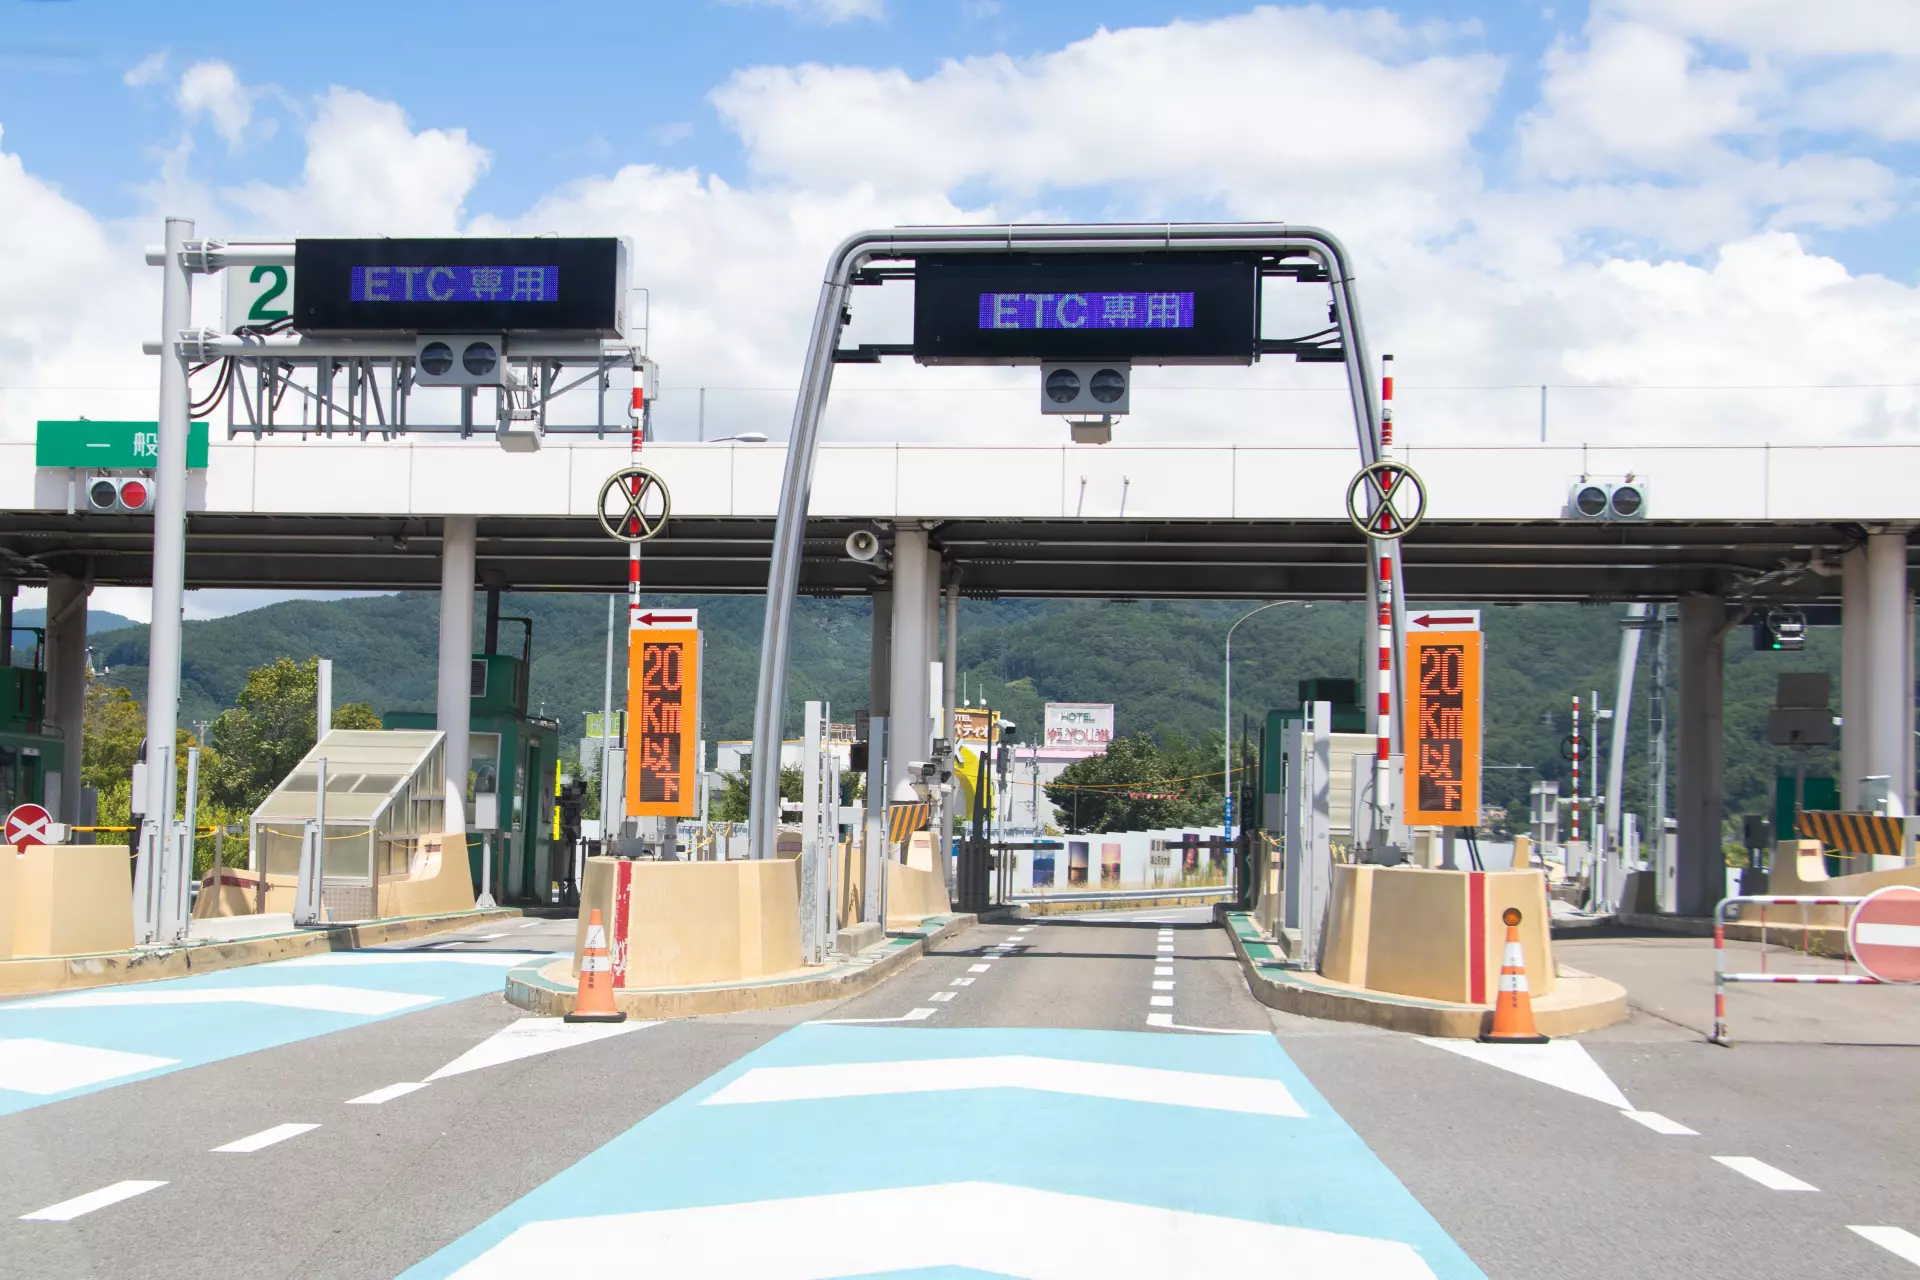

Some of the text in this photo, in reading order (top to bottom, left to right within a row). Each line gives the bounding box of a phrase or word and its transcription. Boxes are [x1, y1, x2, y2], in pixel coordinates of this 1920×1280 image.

[248, 265, 288, 321] 2
[364, 266, 545, 301] ETC 専用
[993, 293, 1180, 328] ETC 専用
[643, 645, 683, 691] 20
[1420, 648, 1464, 695] 20
[1061, 712, 1096, 723] HOTEL
